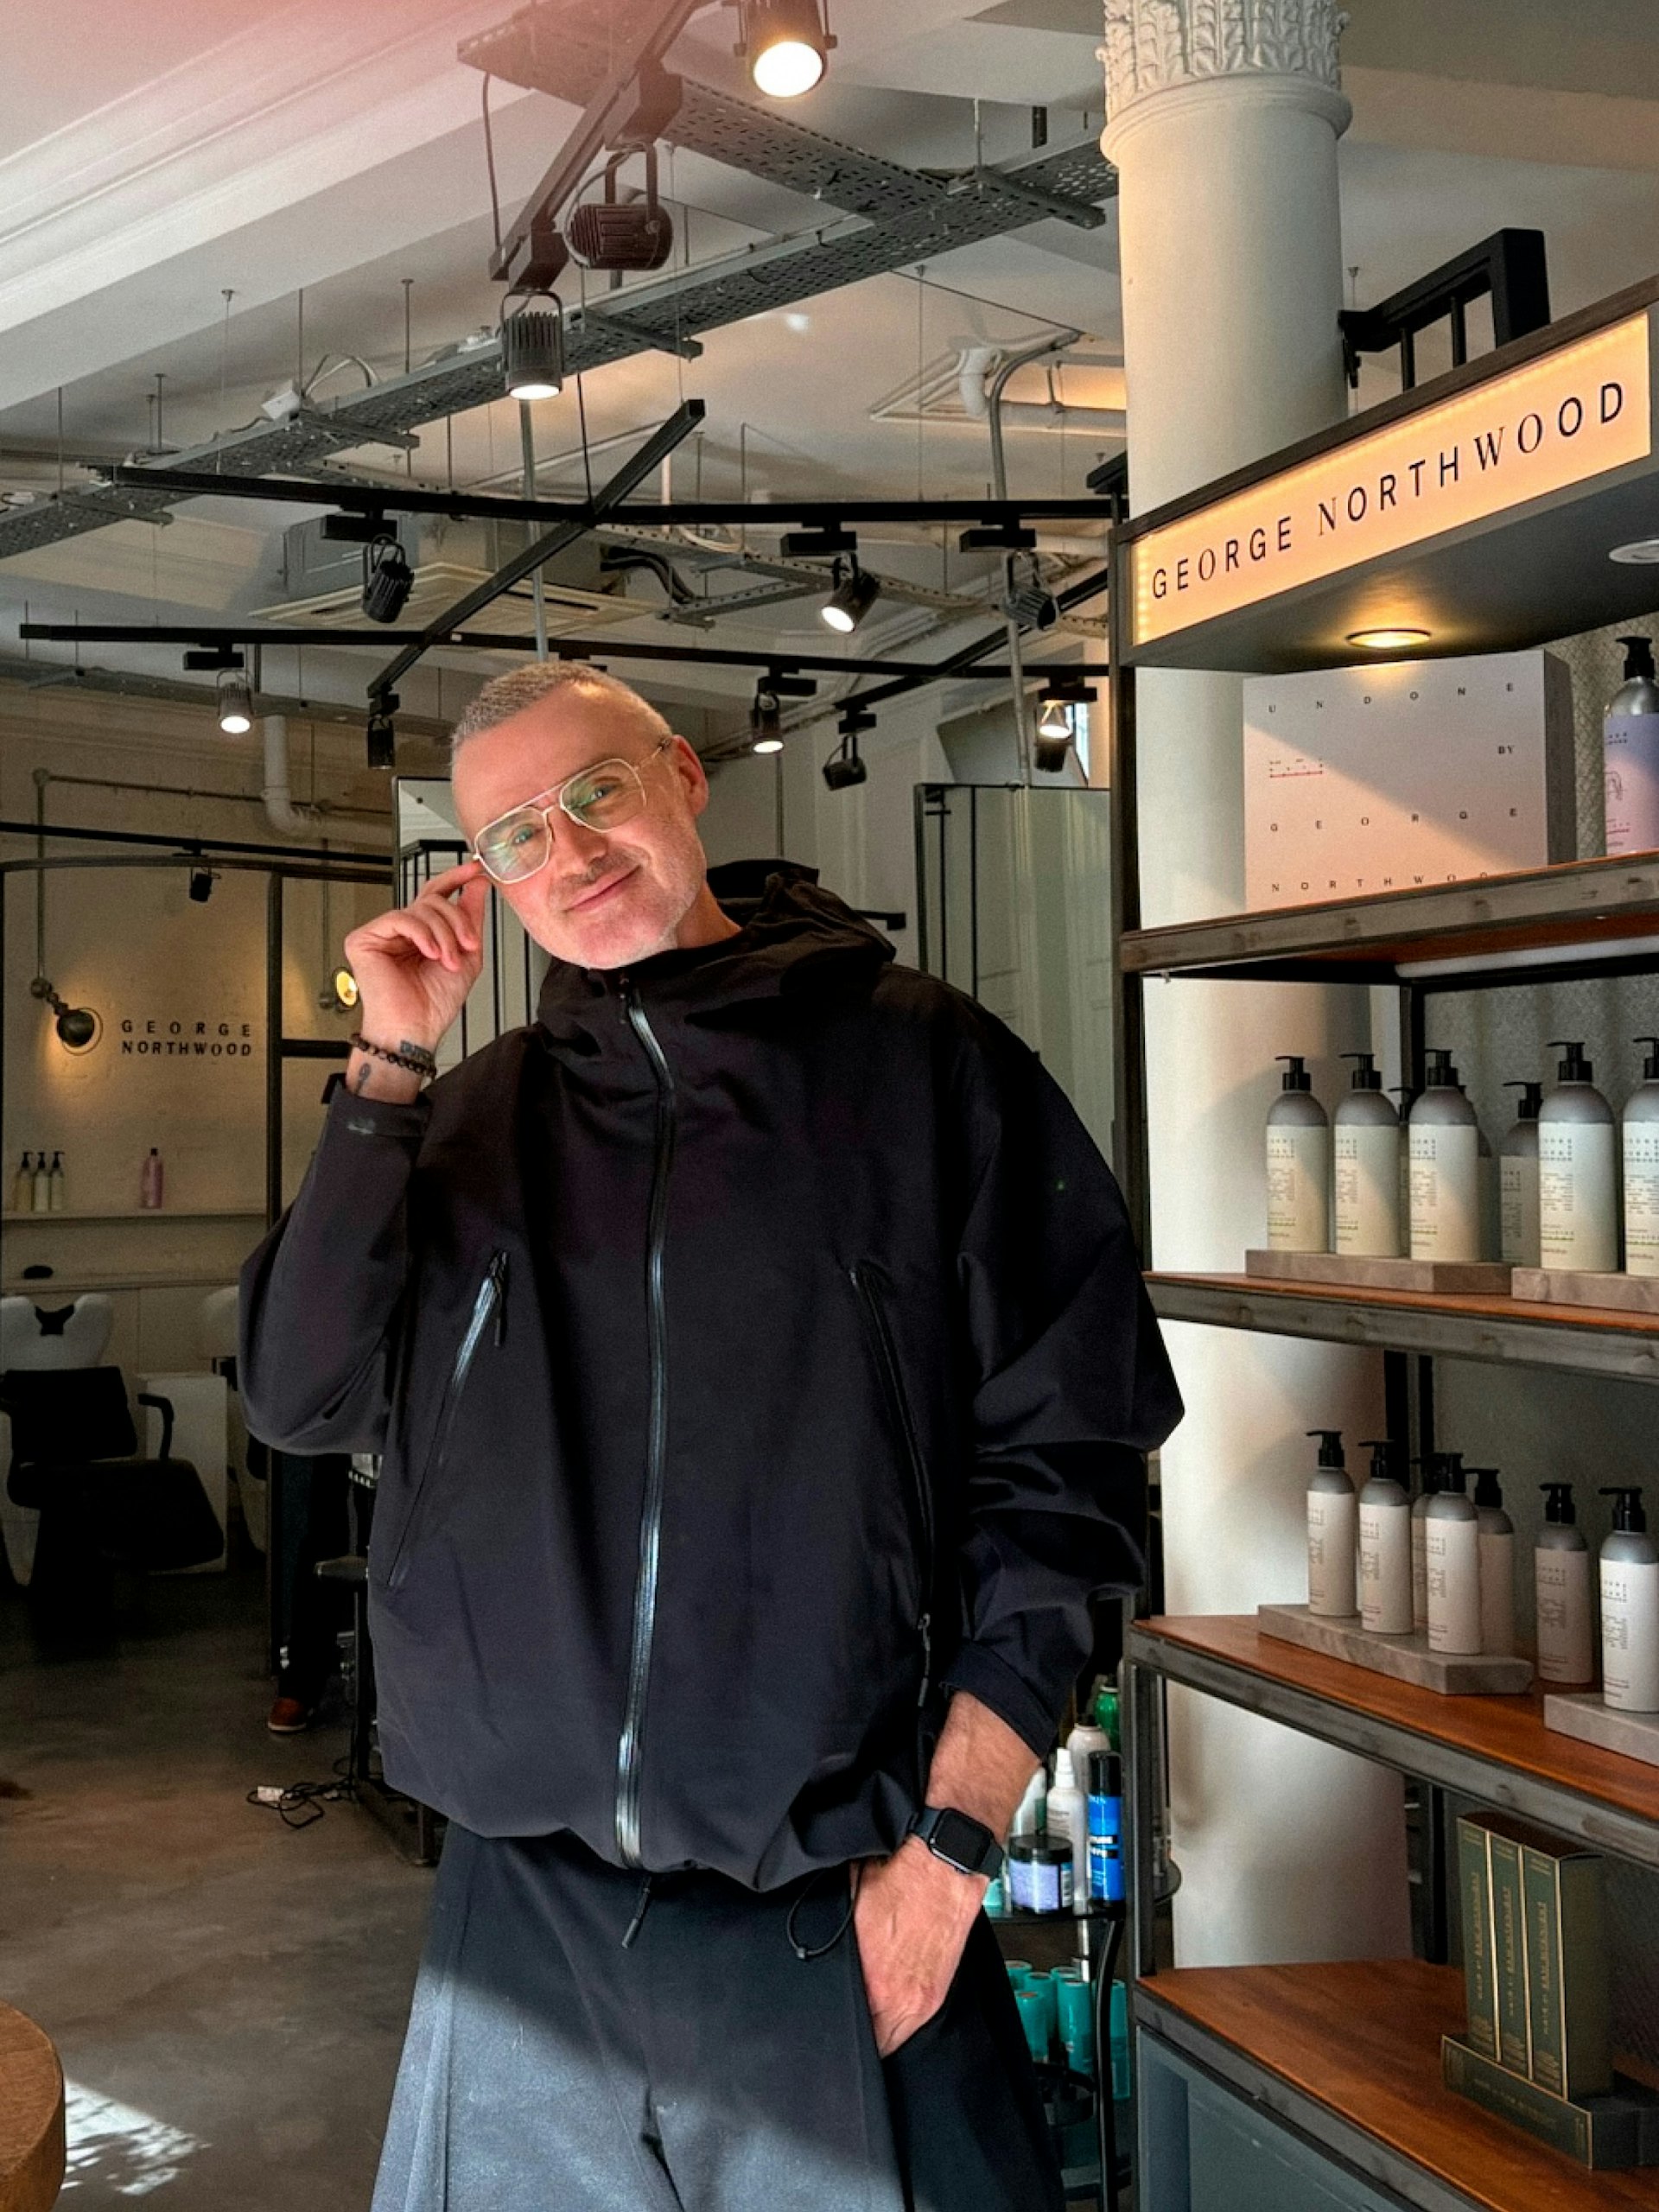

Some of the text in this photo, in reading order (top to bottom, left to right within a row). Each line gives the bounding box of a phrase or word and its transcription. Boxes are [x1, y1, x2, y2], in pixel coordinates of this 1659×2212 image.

[1152, 381, 1624, 599] GEORGE NORTHWOOD
[1268, 683, 1514, 714] UNDONE
[1497, 744, 1514, 755] BY
[1270, 808, 1517, 832] GEORGE
[1271, 871, 1488, 893] NORTHWOO
[122, 1020, 251, 1036] GEORGE
[122, 1041, 251, 1056] NORTHWOOD
